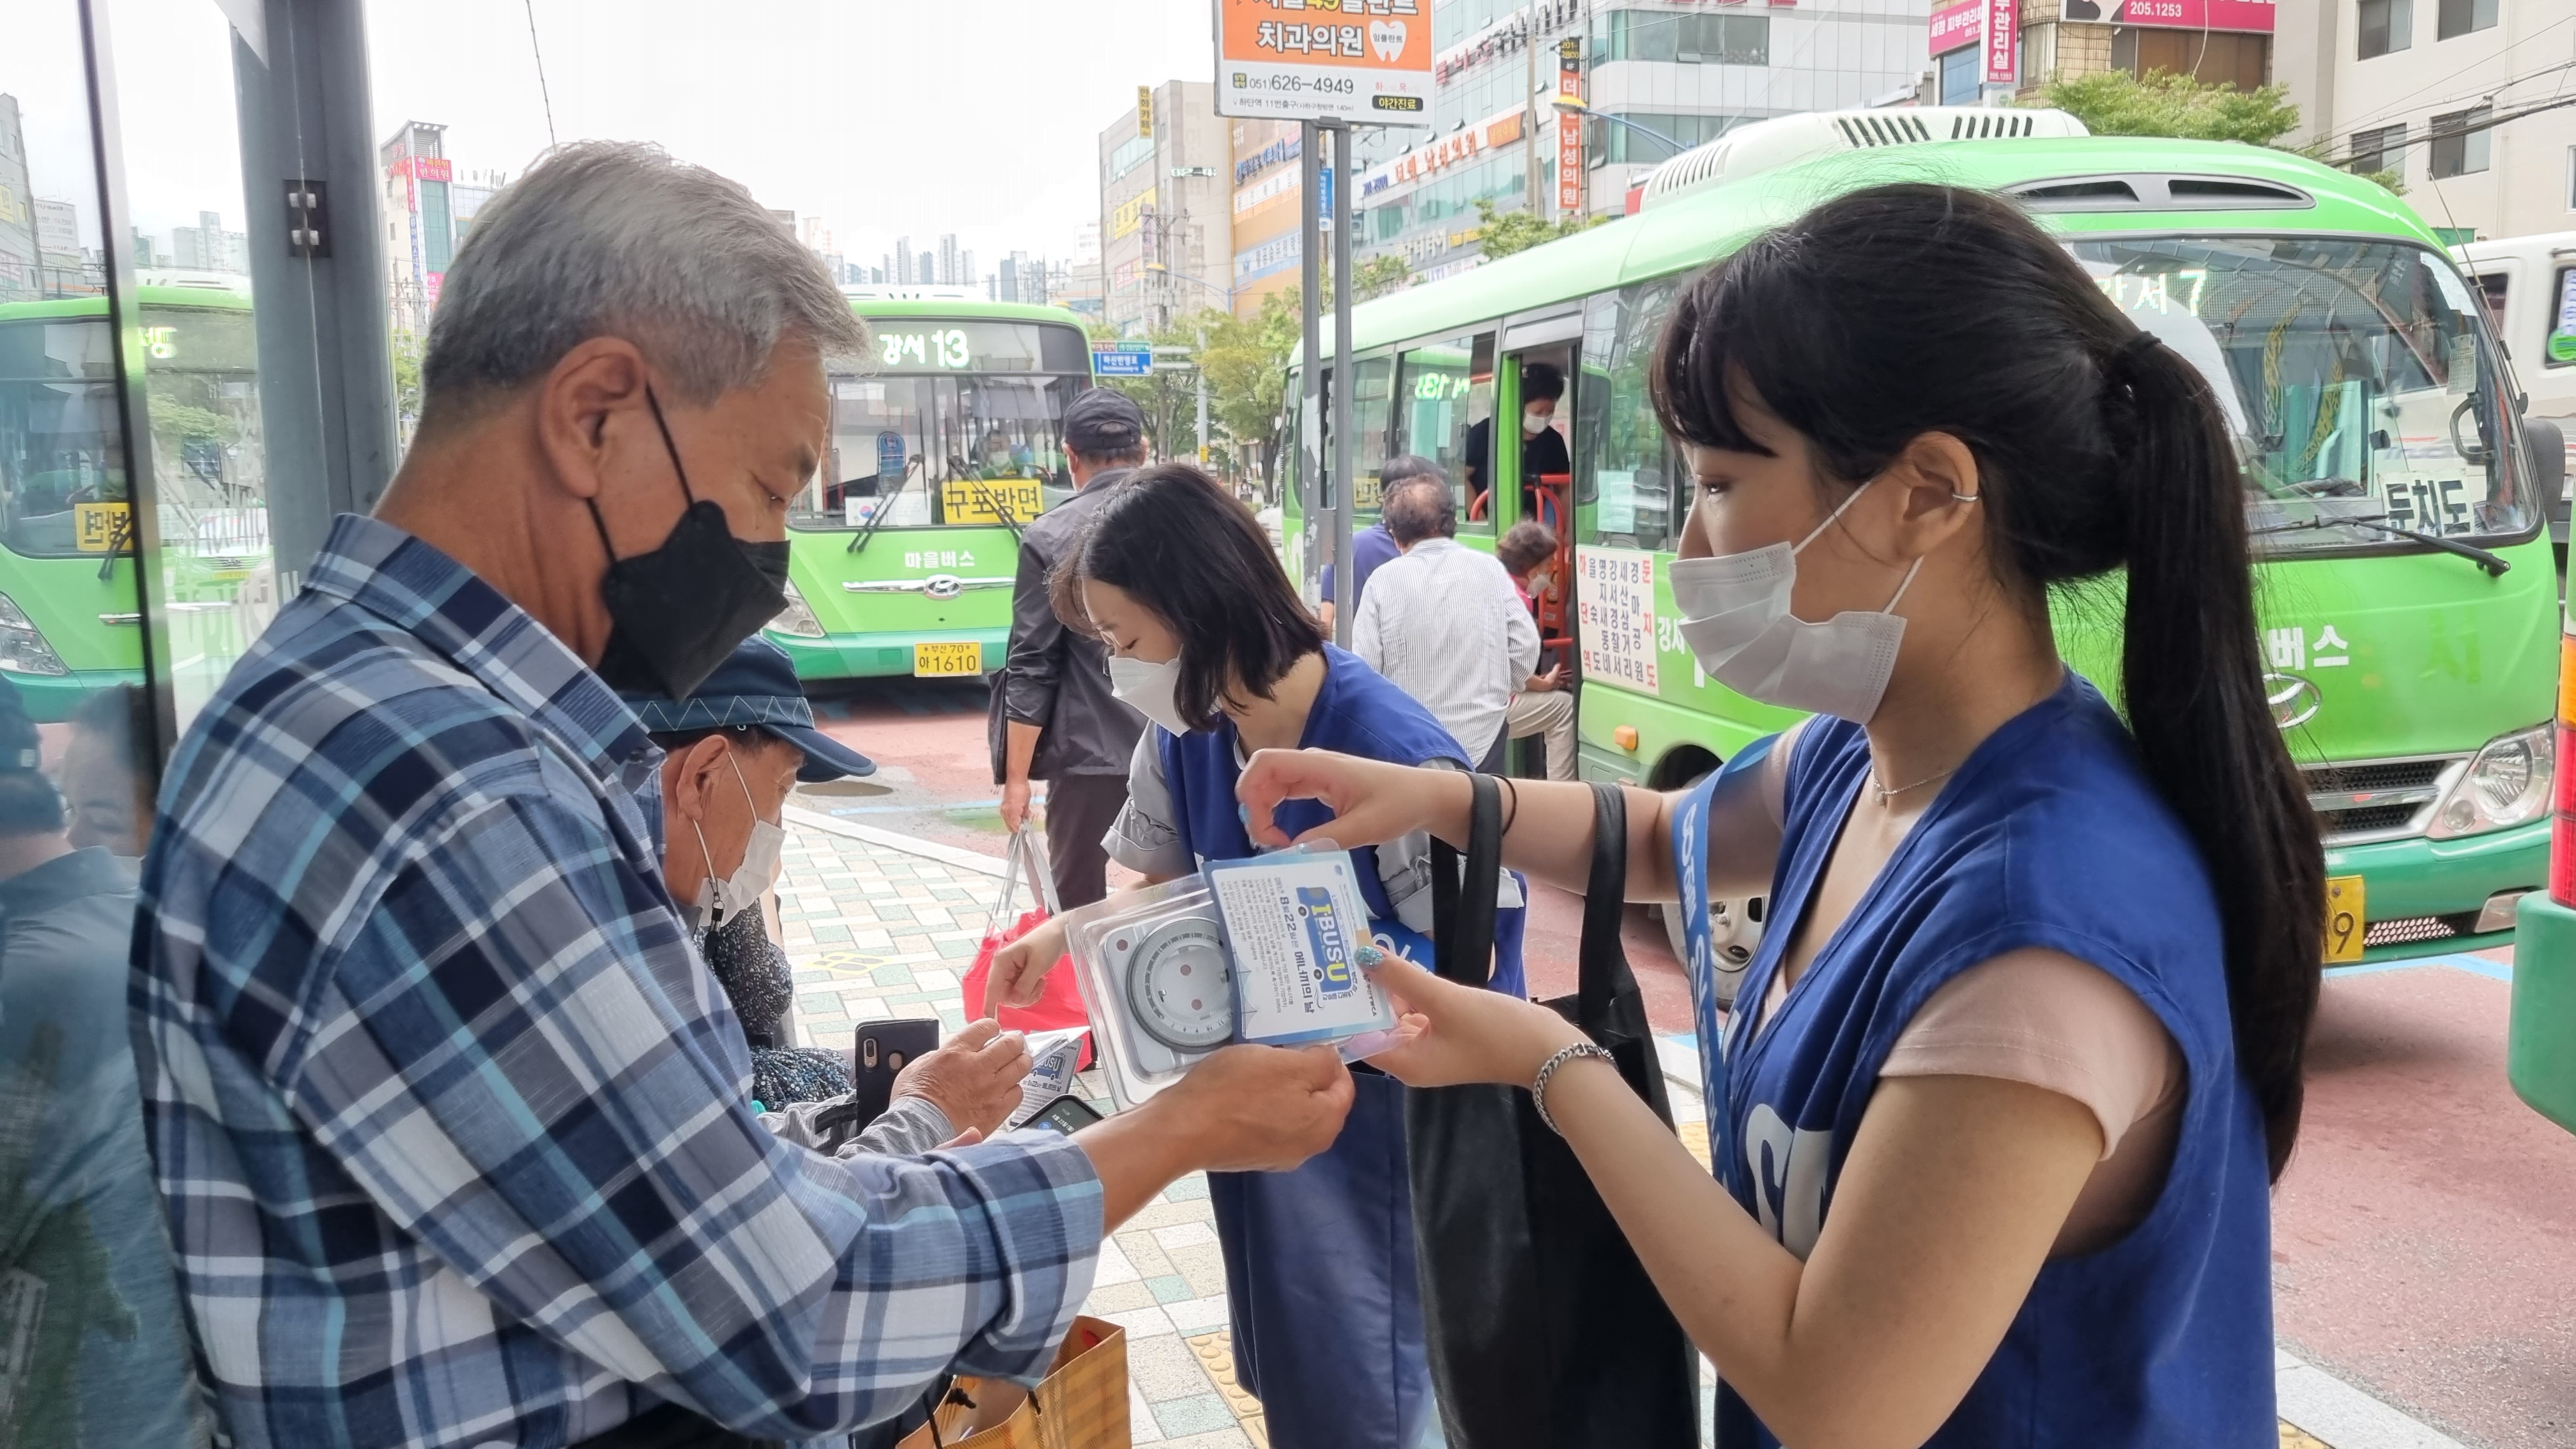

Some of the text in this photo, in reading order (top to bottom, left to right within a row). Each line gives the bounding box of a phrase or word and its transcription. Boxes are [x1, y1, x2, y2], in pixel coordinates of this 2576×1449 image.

[2130, 1, 2182, 17] 205.1253
[1256, 20, 1364, 57] 치과의원
[1373, 33, 1403, 43] 임플란트
[1989, 72, 2012, 80] 205.1253
[1239, 98, 1262, 108] 하단역
[1378, 96, 1416, 111] 야간진료
[1425, 130, 1477, 174] 남성의원
[419, 168, 450, 180] 한의원
[1563, 129, 1579, 205] 남성의원
[2180, 268, 2206, 318] 7
[878, 329, 970, 369] 강서 13
[946, 486, 1040, 519] 구포방면
[2385, 479, 2471, 537] 둔치도
[905, 550, 976, 569] 마을버스
[931, 645, 964, 654] 부산 70
[1303, 1001, 1315, 1015] 날
